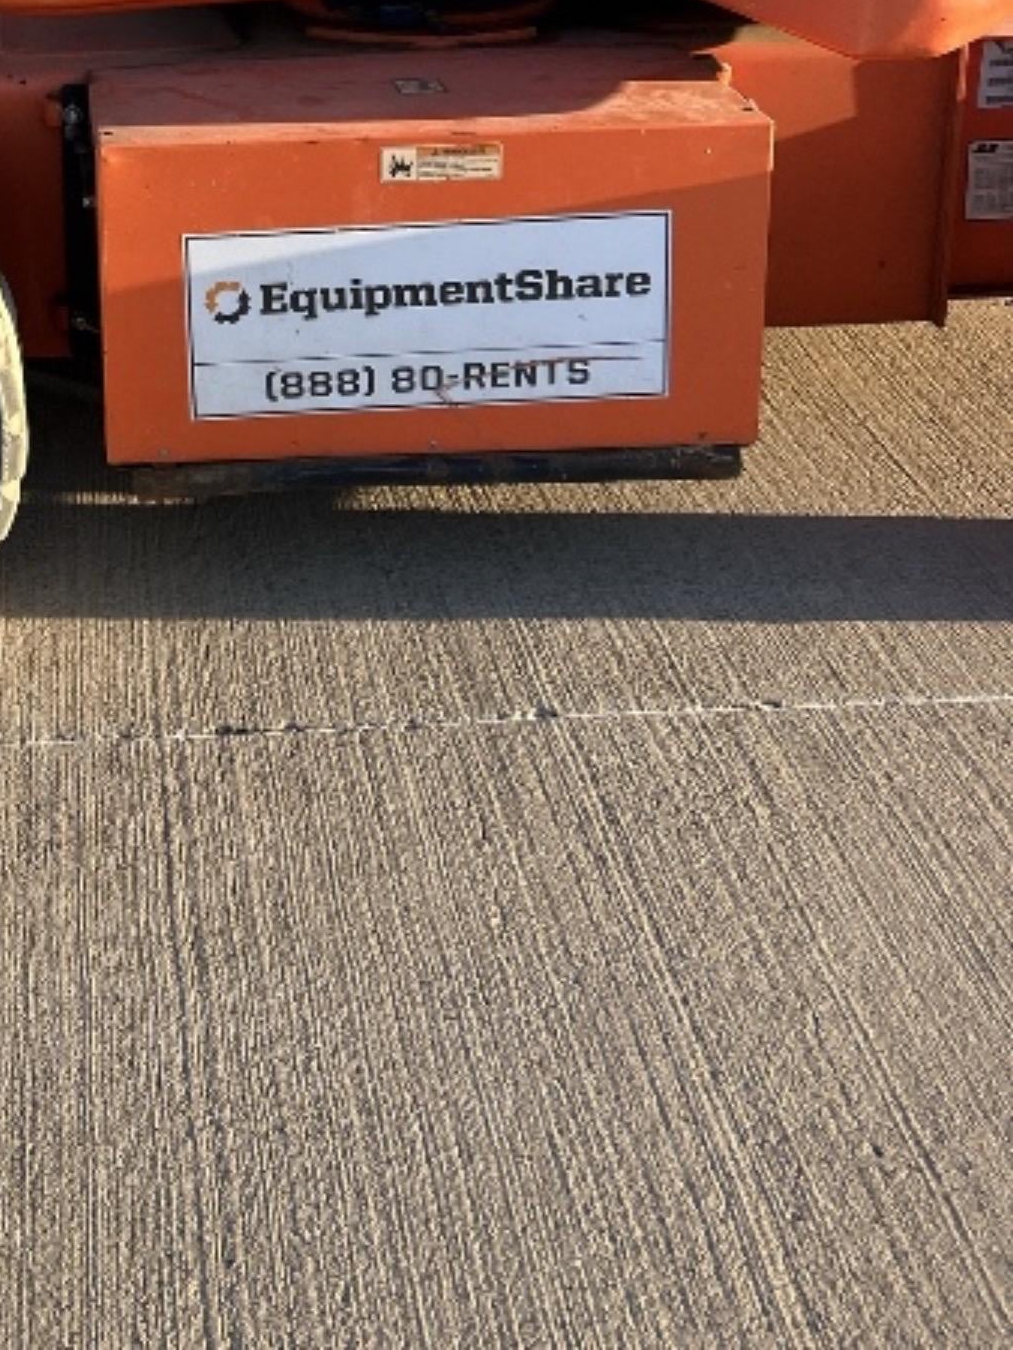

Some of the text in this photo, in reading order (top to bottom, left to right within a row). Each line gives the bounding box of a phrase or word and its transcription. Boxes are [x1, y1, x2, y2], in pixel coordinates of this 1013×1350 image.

[258, 268, 651, 321] EquipmentShare
[264, 357, 592, 402] (888) 80-RENTS
